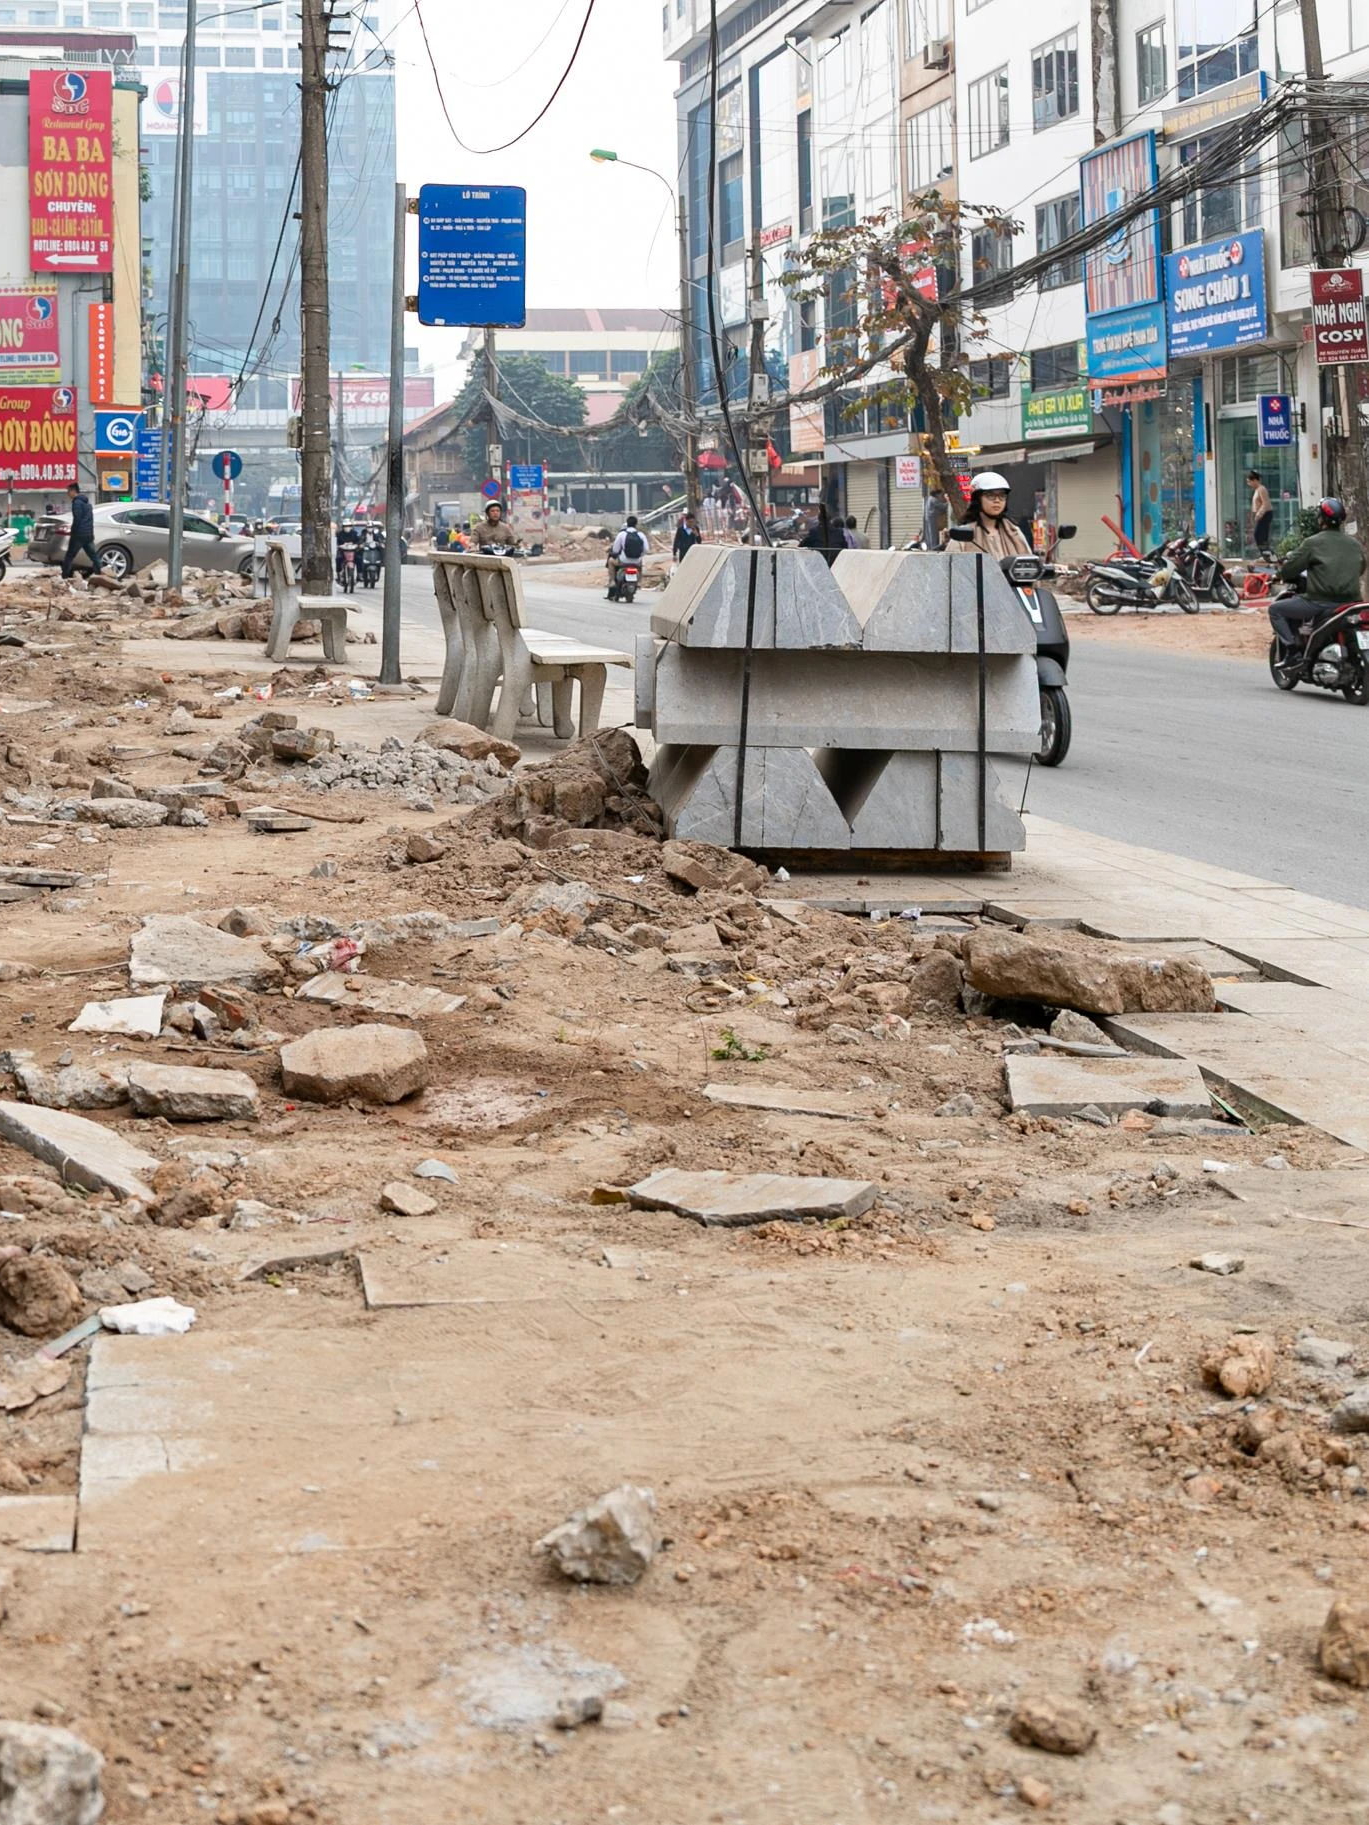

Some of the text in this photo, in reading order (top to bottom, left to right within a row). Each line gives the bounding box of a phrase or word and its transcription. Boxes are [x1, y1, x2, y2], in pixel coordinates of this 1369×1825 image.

[43, 136, 105, 163] BA BA
[34, 164, 109, 198] SƠN ĐÔNG
[1174, 273, 1251, 313] SONG CHÂU 1
[1315, 294, 1364, 327] NHÀ NGHỈ
[1319, 328, 1364, 344] COSY
[0, 395, 32, 412] Group
[30, 411, 76, 453] ĐÔNG
[1264, 425, 1290, 440] THUỐC
[1268, 414, 1284, 426] NHÀ
